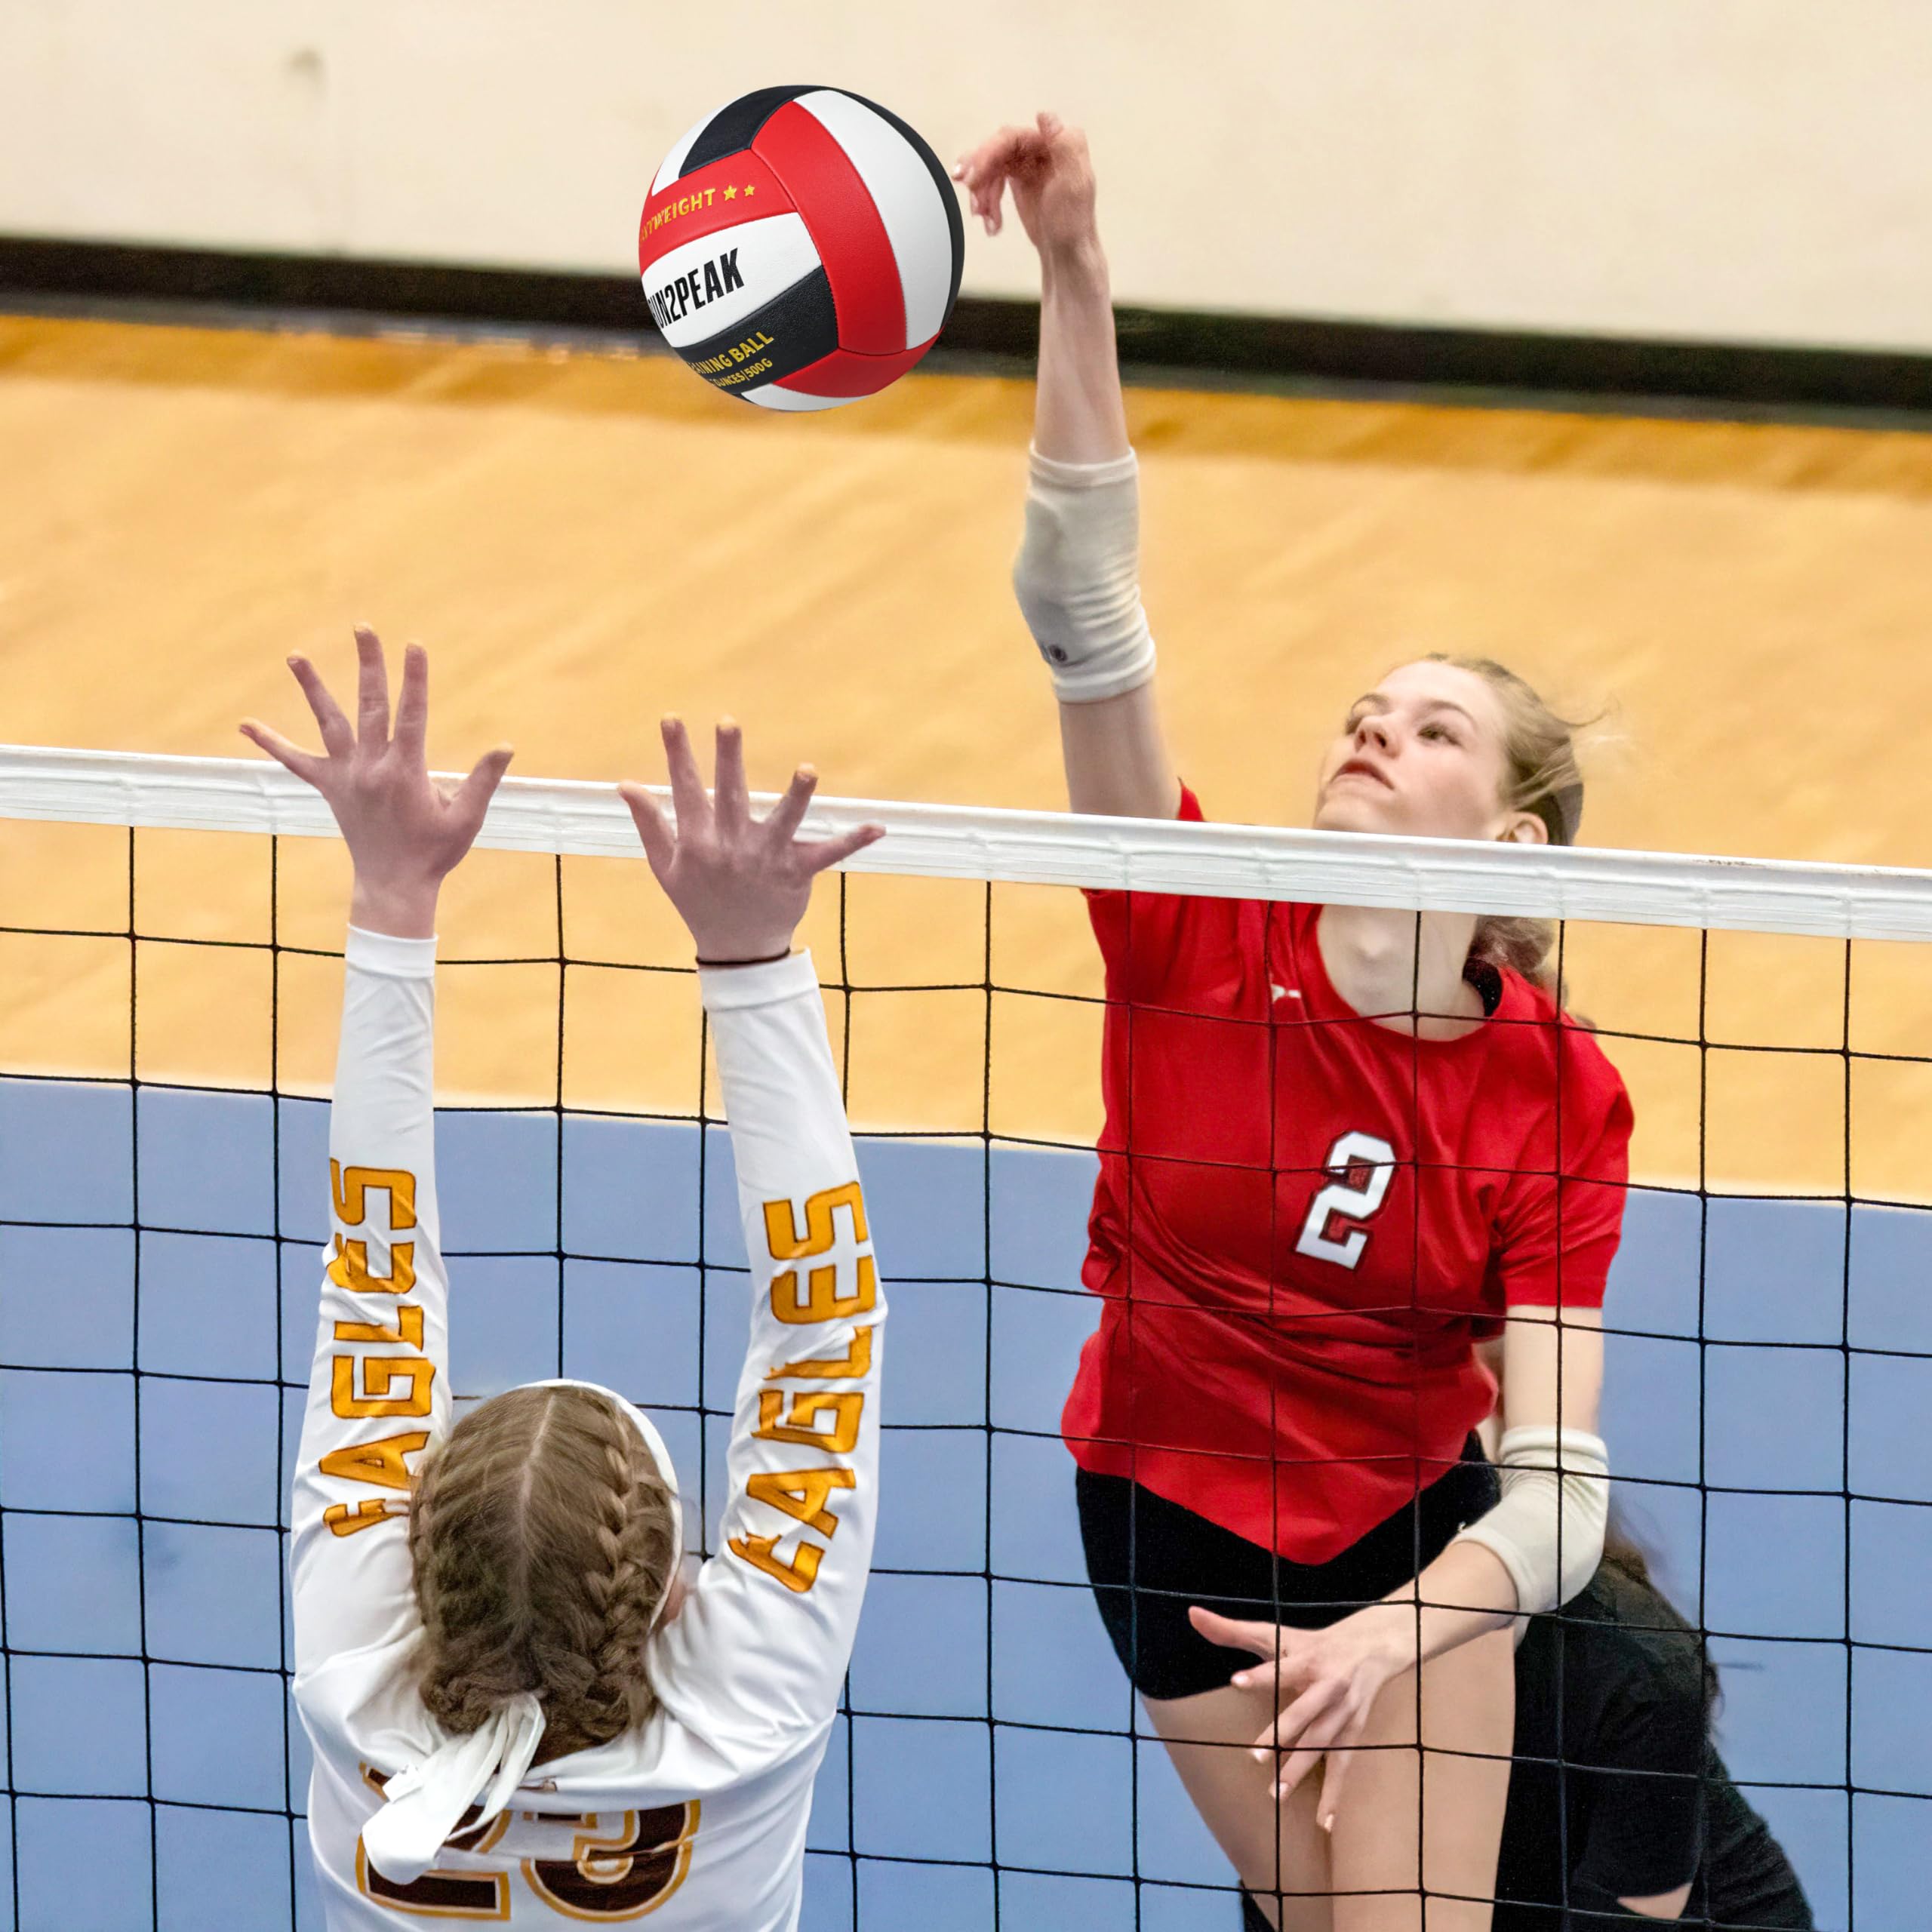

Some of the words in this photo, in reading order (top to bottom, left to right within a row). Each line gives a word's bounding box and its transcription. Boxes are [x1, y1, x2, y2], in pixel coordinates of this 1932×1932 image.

[688, 354, 733, 374] AINING
[728, 331, 774, 362] BALL
[1292, 1129, 1398, 1271] 2
[320, 1158, 435, 1537] EAGLES
[728, 1181, 875, 1592] EAGLES
